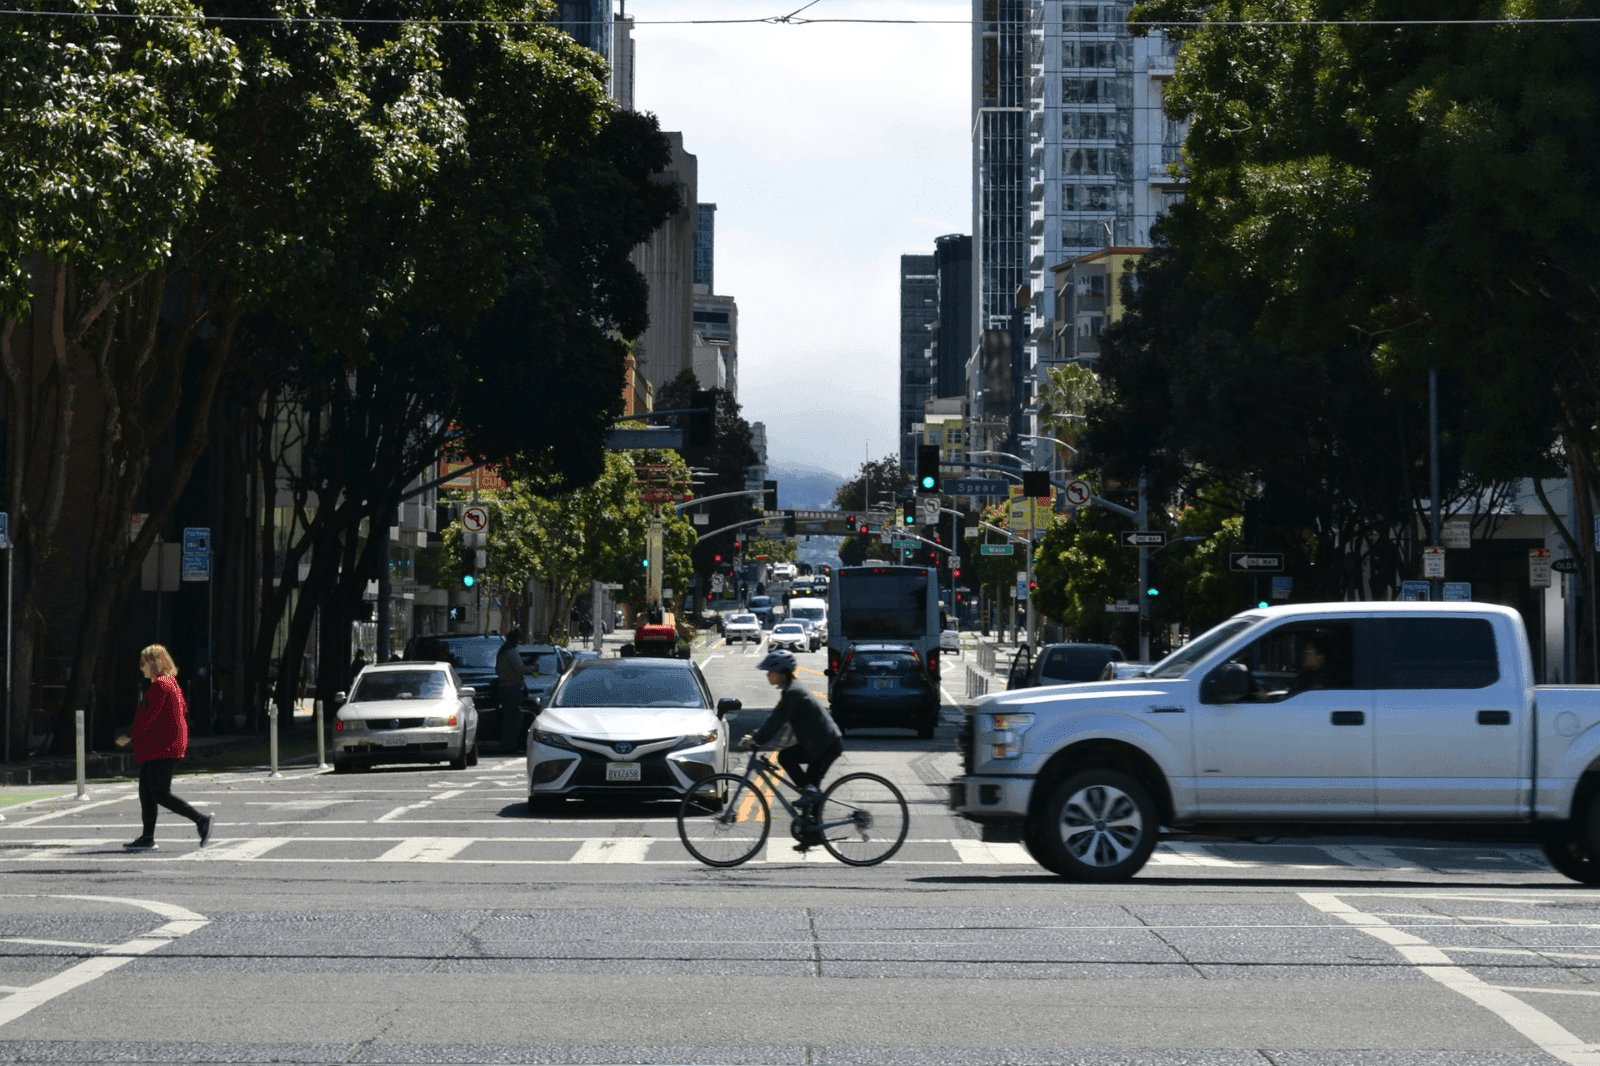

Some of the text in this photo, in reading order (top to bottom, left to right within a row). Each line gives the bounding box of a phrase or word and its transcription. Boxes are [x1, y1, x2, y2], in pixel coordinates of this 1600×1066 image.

[958, 482, 997, 494] Spear
[1246, 558, 1277, 566] ONE WAY
[1556, 561, 1573, 570] OLD
